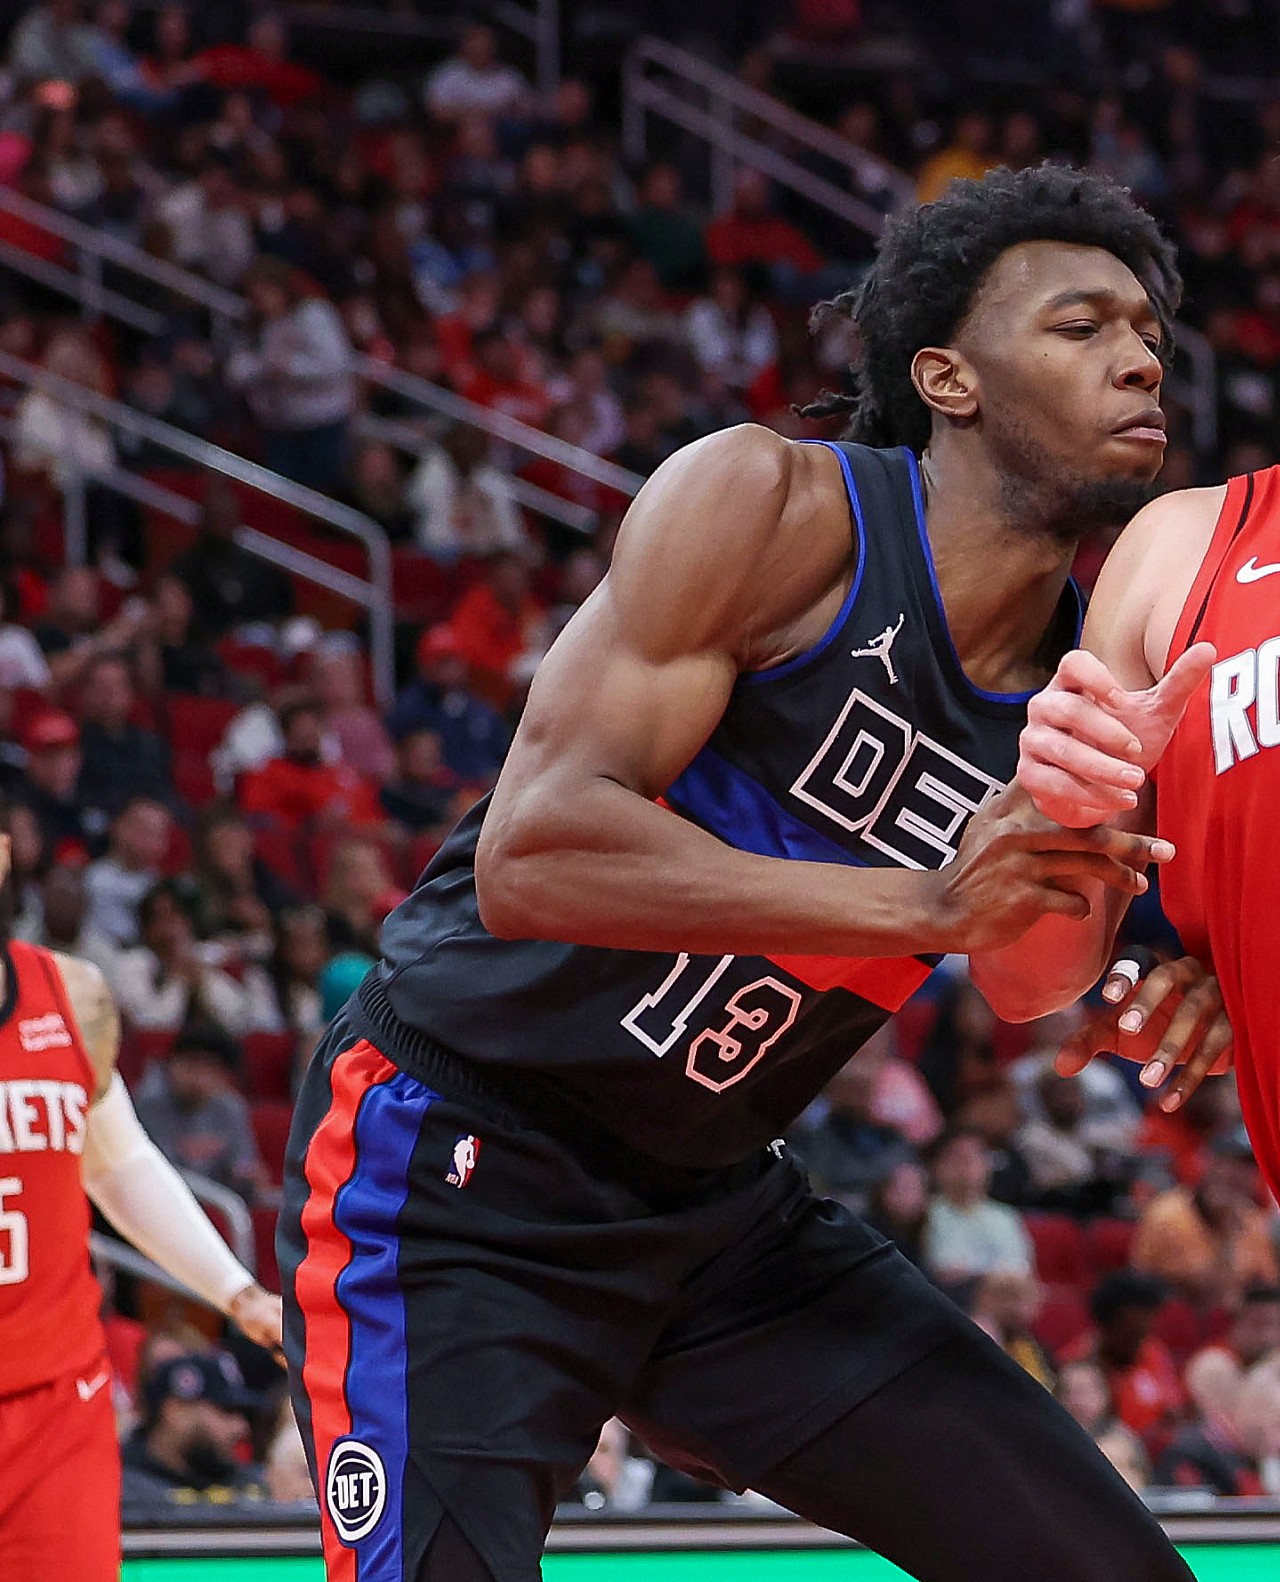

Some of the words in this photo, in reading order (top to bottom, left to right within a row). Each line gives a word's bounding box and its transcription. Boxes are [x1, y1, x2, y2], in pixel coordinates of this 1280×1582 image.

[789, 687, 1007, 871] DE
[620, 952, 801, 1094] 13
[0, 1176, 29, 1286] 5
[336, 1472, 373, 1510] DET
